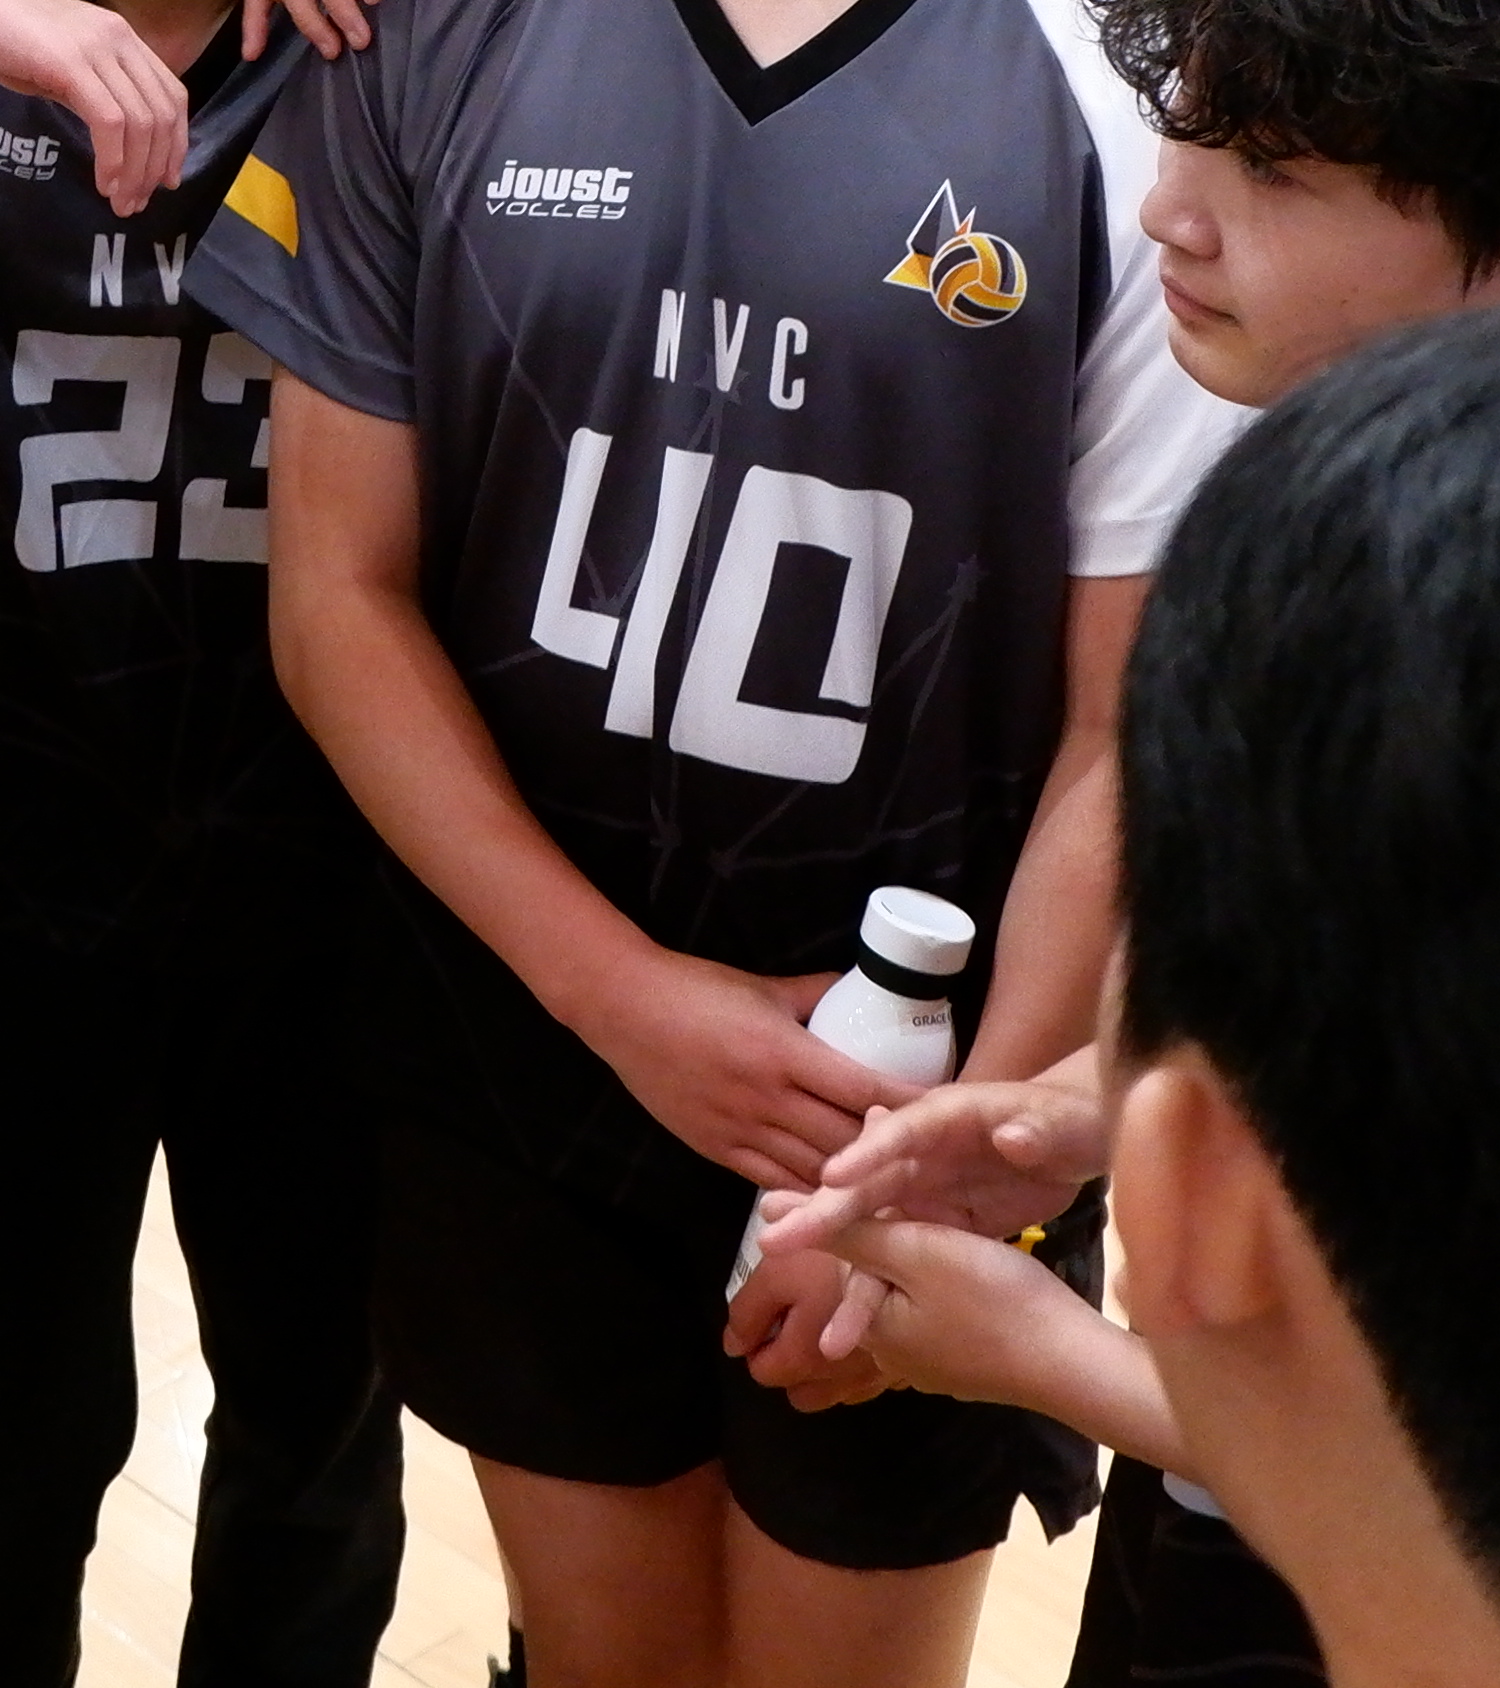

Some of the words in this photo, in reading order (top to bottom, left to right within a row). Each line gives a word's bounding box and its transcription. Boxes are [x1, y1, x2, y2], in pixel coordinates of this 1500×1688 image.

[485, 200, 627, 220] VOLLEY
[486, 159, 634, 203] joust
[89, 232, 188, 308] NV
[653, 287, 809, 411] NVC
[530, 426, 913, 785] 40
[912, 1013, 947, 1027] GRACE
